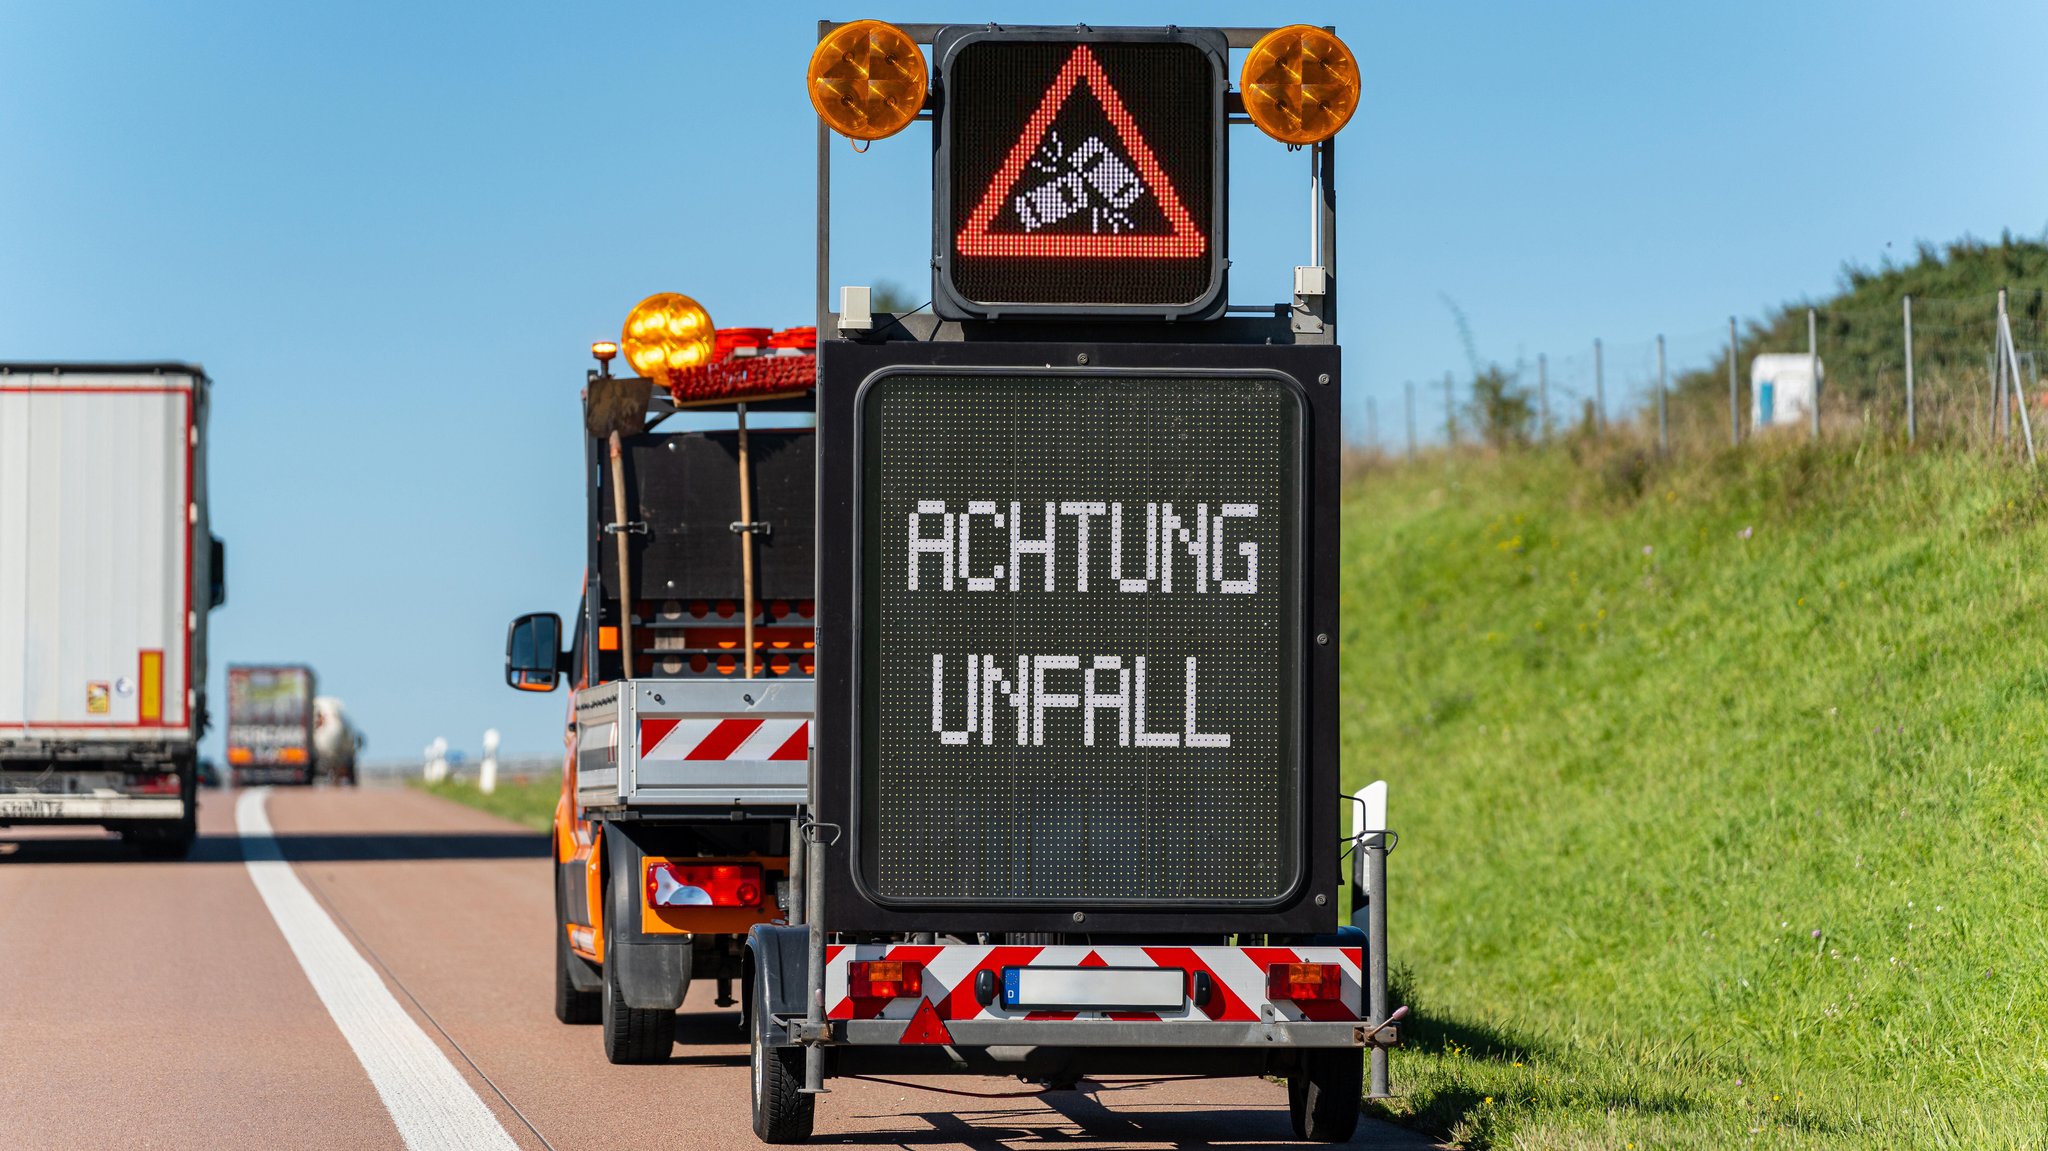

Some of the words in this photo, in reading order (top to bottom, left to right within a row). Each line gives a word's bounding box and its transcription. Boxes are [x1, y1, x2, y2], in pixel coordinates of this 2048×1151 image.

[908, 501, 1258, 594] ACHTUNG
[932, 654, 1231, 747] UNFALL
[1007, 989, 1015, 998] D
